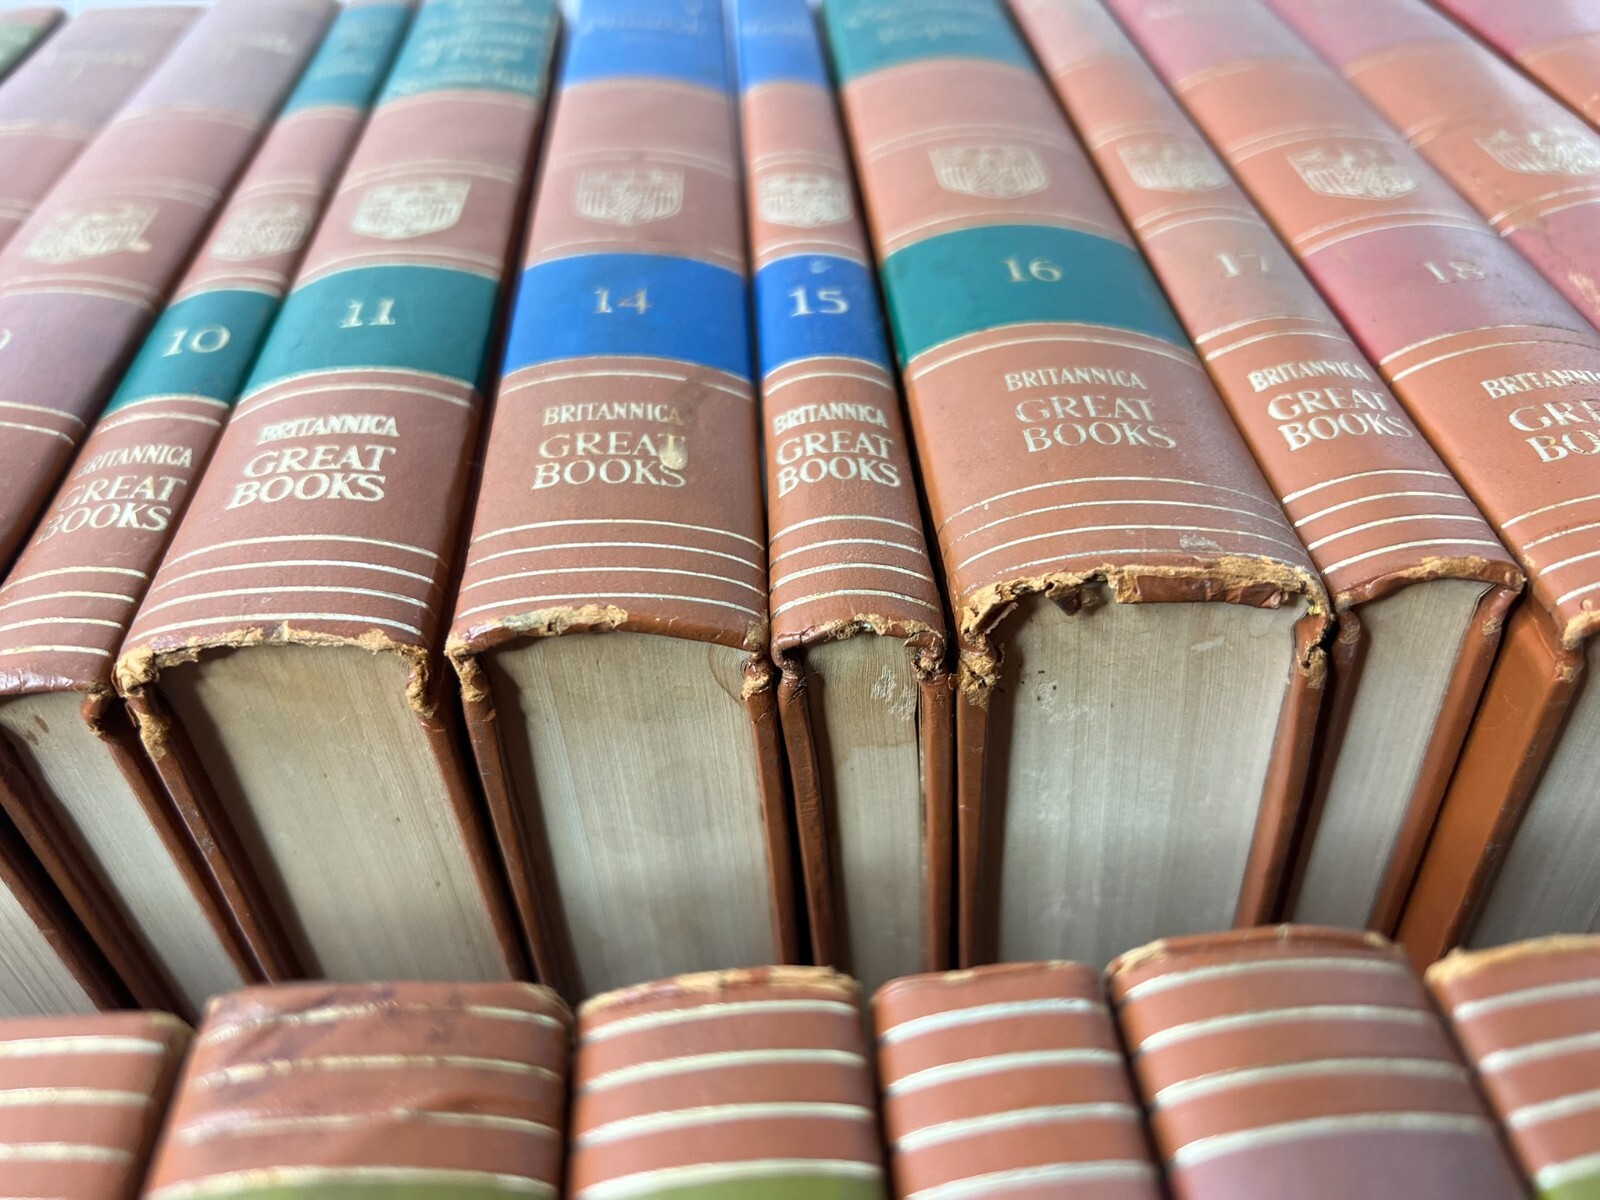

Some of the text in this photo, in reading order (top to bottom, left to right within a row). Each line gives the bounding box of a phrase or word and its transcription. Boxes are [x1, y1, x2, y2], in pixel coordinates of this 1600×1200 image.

[1003, 256, 1063, 283] 16
[1217, 252, 1269, 278] 17
[1424, 261, 1486, 284] 18
[339, 298, 396, 328] 11
[592, 287, 652, 315] 14
[790, 288, 850, 317] 15
[162, 325, 231, 358] 10
[1004, 367, 1148, 392] BRITANNICA
[1246, 360, 1373, 393] BRITANNICA
[543, 401, 684, 427] BRITANNICA
[773, 402, 888, 437] BRITANNICA
[1014, 395, 1156, 423] GREAT
[1267, 387, 1388, 421] GREAT
[256, 414, 400, 446] BRITANNICA
[538, 431, 686, 460] GREAT
[1022, 421, 1177, 453] BOOKS
[1277, 412, 1413, 451] BOOKS
[74, 444, 193, 480] BRITANNICA
[243, 444, 396, 478] GREAT
[776, 431, 893, 466] GREAT
[531, 458, 687, 490] BOOKS
[776, 456, 901, 499] BOOKS
[56, 475, 187, 513] GREAT
[225, 472, 386, 511] BOOKS
[37, 502, 172, 545] BOOKS
